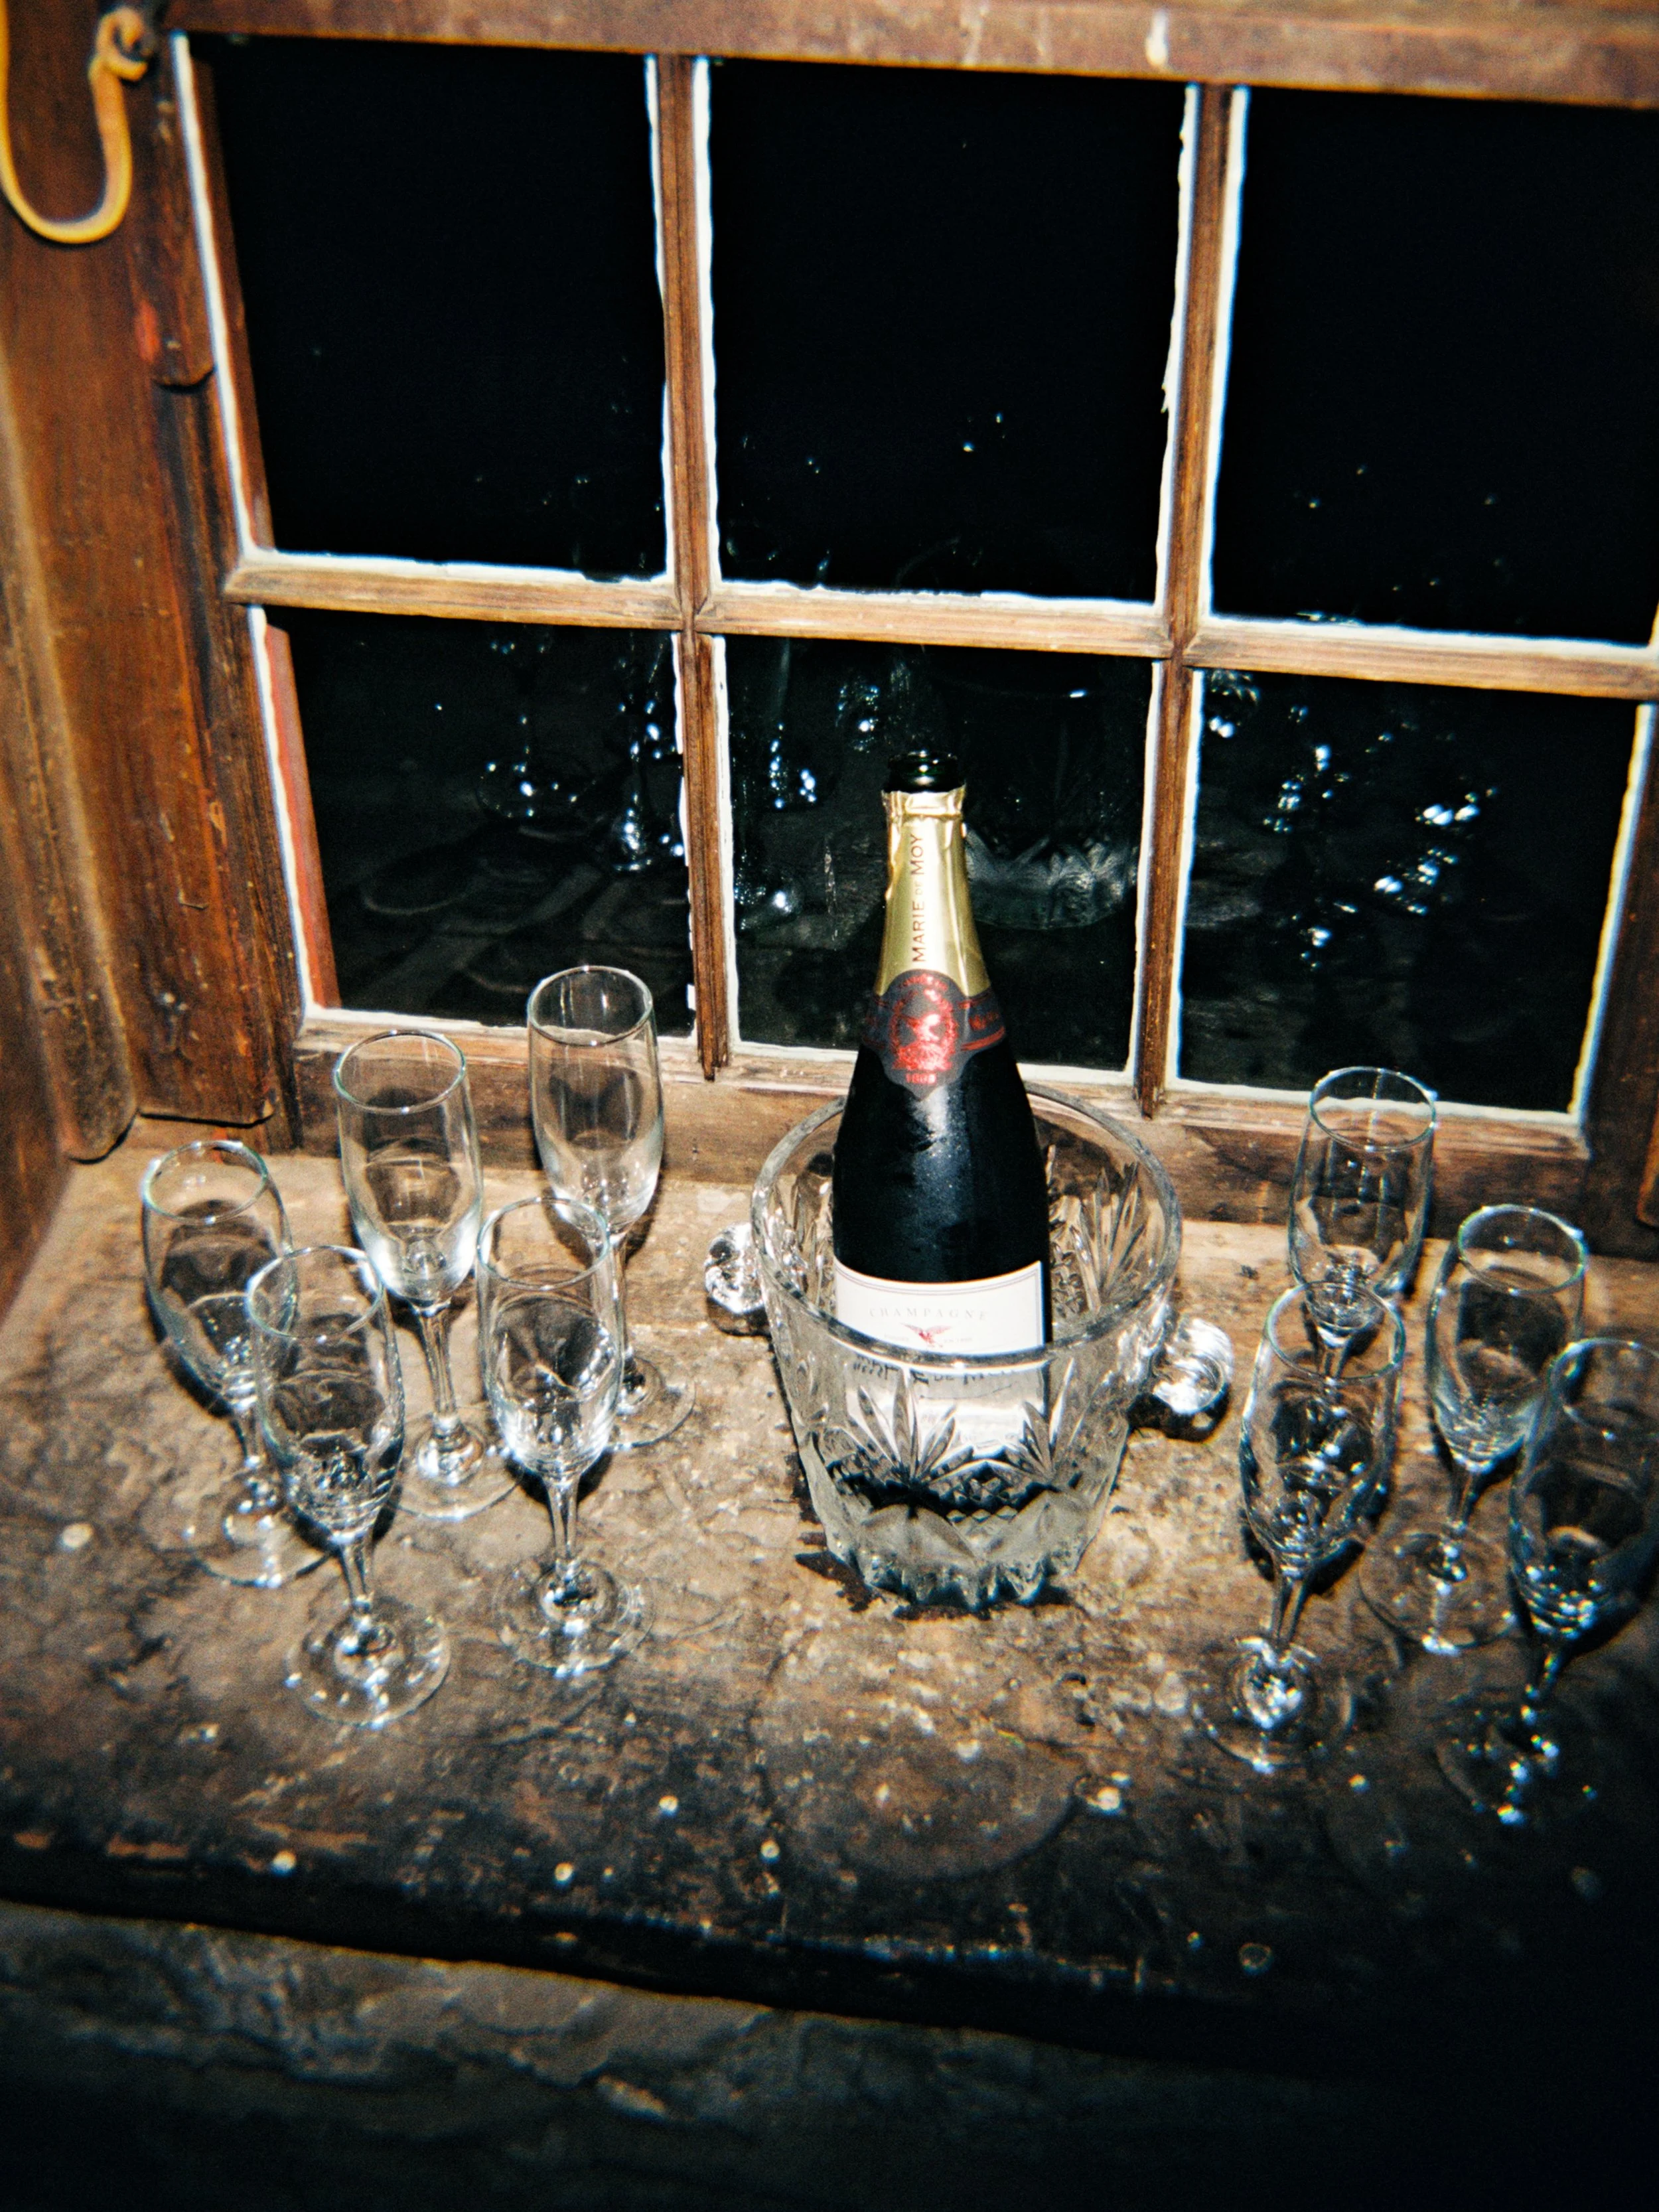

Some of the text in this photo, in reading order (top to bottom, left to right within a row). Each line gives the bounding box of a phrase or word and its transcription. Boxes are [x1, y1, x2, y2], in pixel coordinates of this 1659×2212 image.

[909, 833, 924, 875] MOY
[912, 901, 926, 962] MARIE
[868, 1307, 989, 1321] CHAMPAGNE
